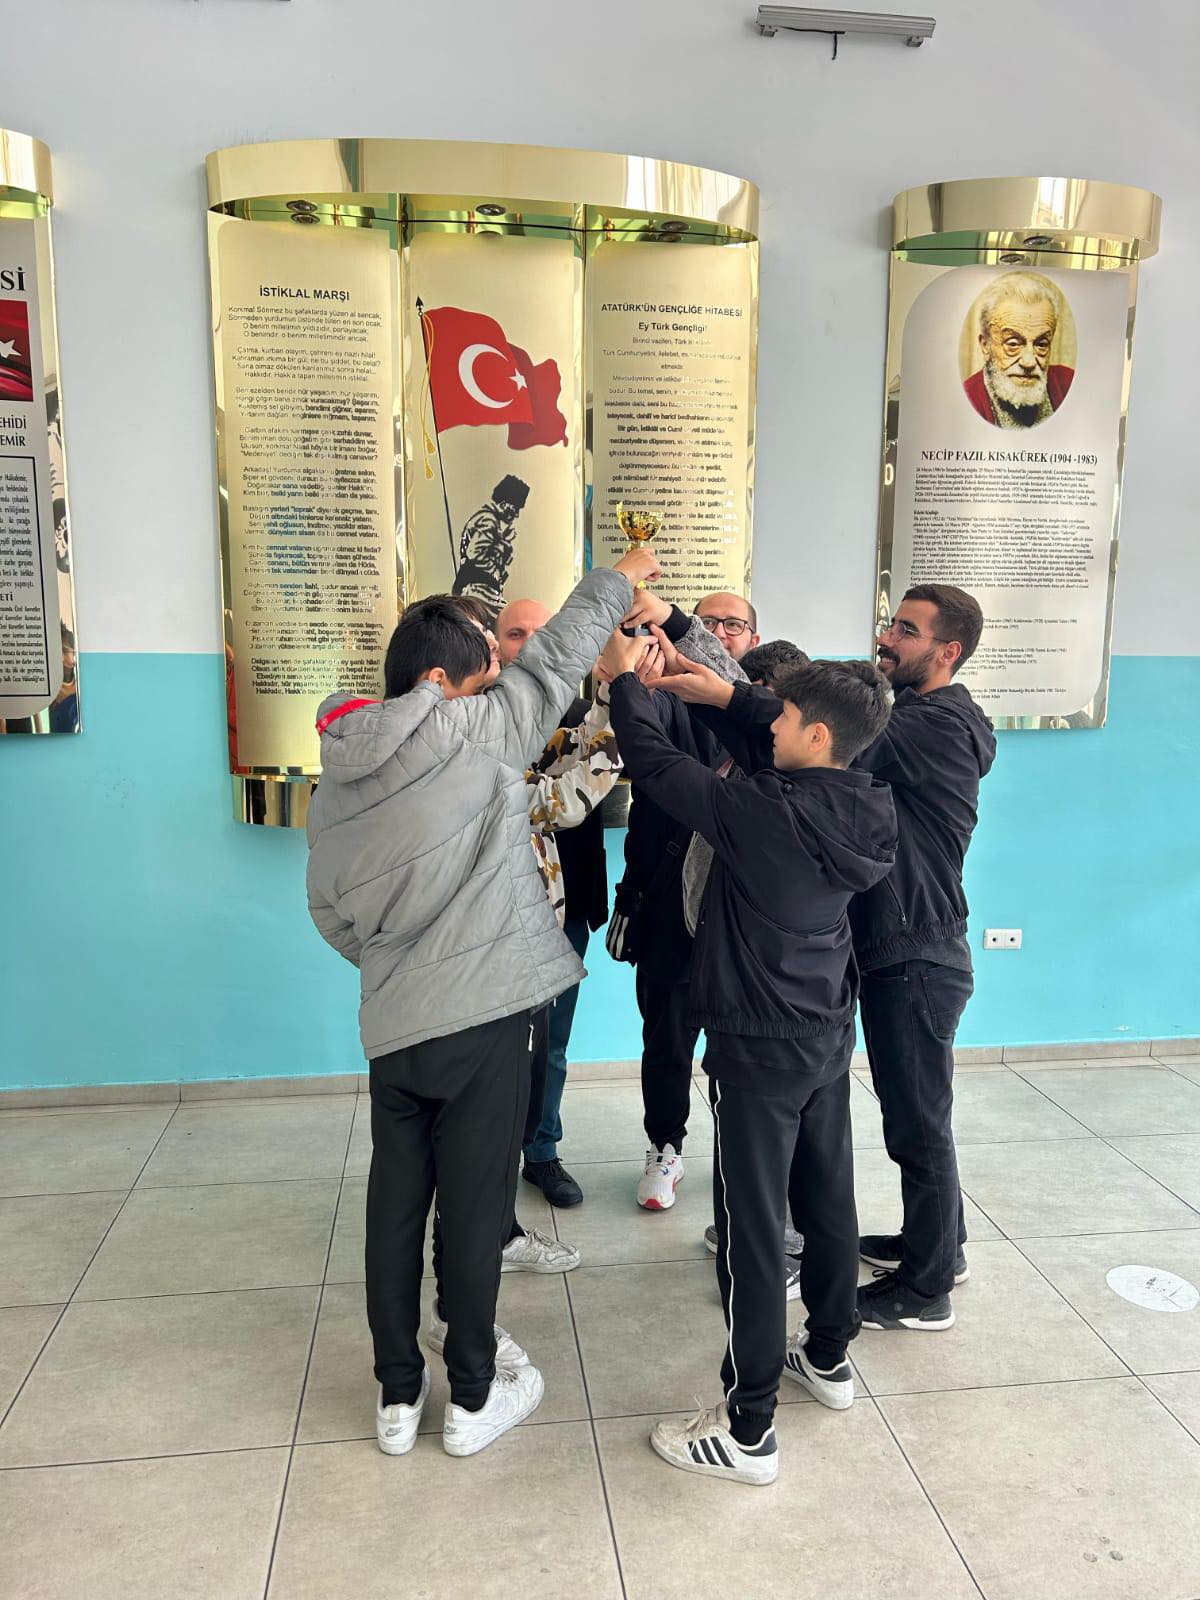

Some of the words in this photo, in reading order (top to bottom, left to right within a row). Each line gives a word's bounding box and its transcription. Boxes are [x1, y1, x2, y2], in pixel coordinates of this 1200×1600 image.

[260, 285, 310, 299] İSTİKLAL
[314, 290, 350, 302] MARŞI
[601, 303, 656, 312] ATATÜRK'ÜN
[658, 303, 702, 315] GENÇLİĞE
[705, 307, 742, 317] HİTABESİ
[638, 323, 649, 331] Ey
[921, 449, 953, 461] NECİP
[956, 452, 986, 461] FAZIL
[988, 450, 1048, 463] KISAKÜREK
[1049, 453, 1072, 464] (1904
